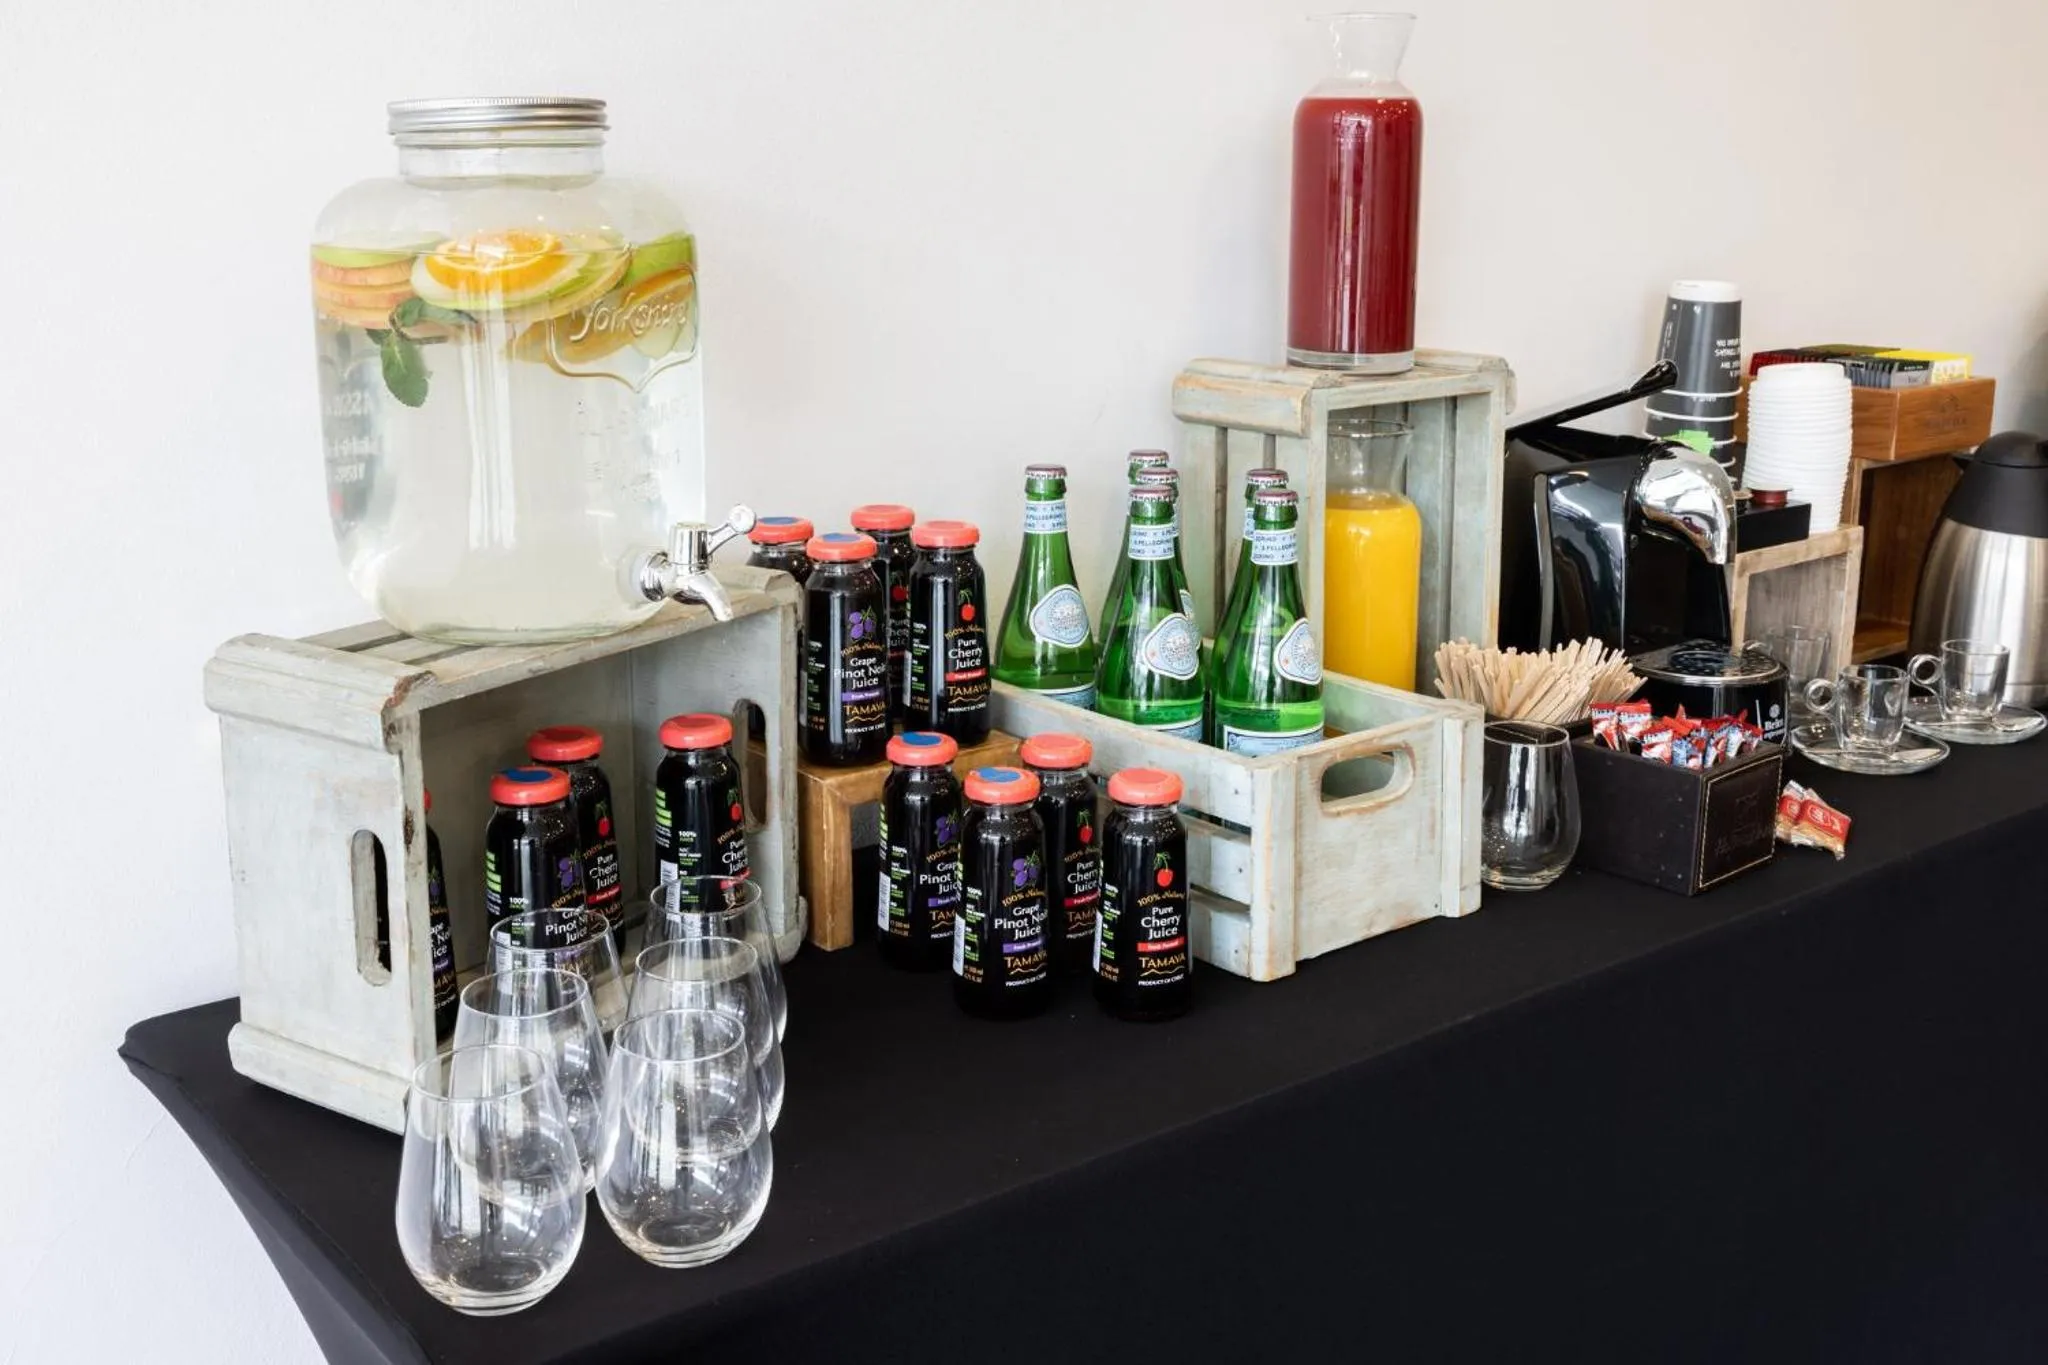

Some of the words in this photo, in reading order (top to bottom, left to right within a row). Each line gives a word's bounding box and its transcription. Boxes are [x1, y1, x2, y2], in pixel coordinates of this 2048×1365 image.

[957, 639, 977, 647] Pure
[948, 647, 982, 659] Cherry
[850, 657, 877, 668] Grape
[956, 658, 981, 670] Juice
[834, 668, 865, 679] Pinot
[852, 677, 879, 689] Juice
[678, 830, 697, 838] 100%
[597, 854, 614, 865] Pure
[1076, 860, 1094, 871] Pure
[596, 873, 618, 891] Juice
[920, 874, 951, 885] Pinot
[1073, 880, 1097, 895] Juice
[509, 897, 529, 905] 100%
[1002, 893, 1024, 907] 100%
[1137, 894, 1160, 907] 100%
[930, 910, 956, 921] TAM
[1013, 904, 1040, 916] Grape
[1152, 906, 1173, 916] Pure
[994, 917, 1028, 929] Pinot
[1141, 914, 1181, 928] Cherry
[545, 920, 577, 936] Pinot
[1014, 925, 1041, 941] Juice
[1148, 926, 1178, 940] Juice
[1138, 953, 1186, 969] TAMAYA
[1138, 979, 1163, 987] PRODUCT
